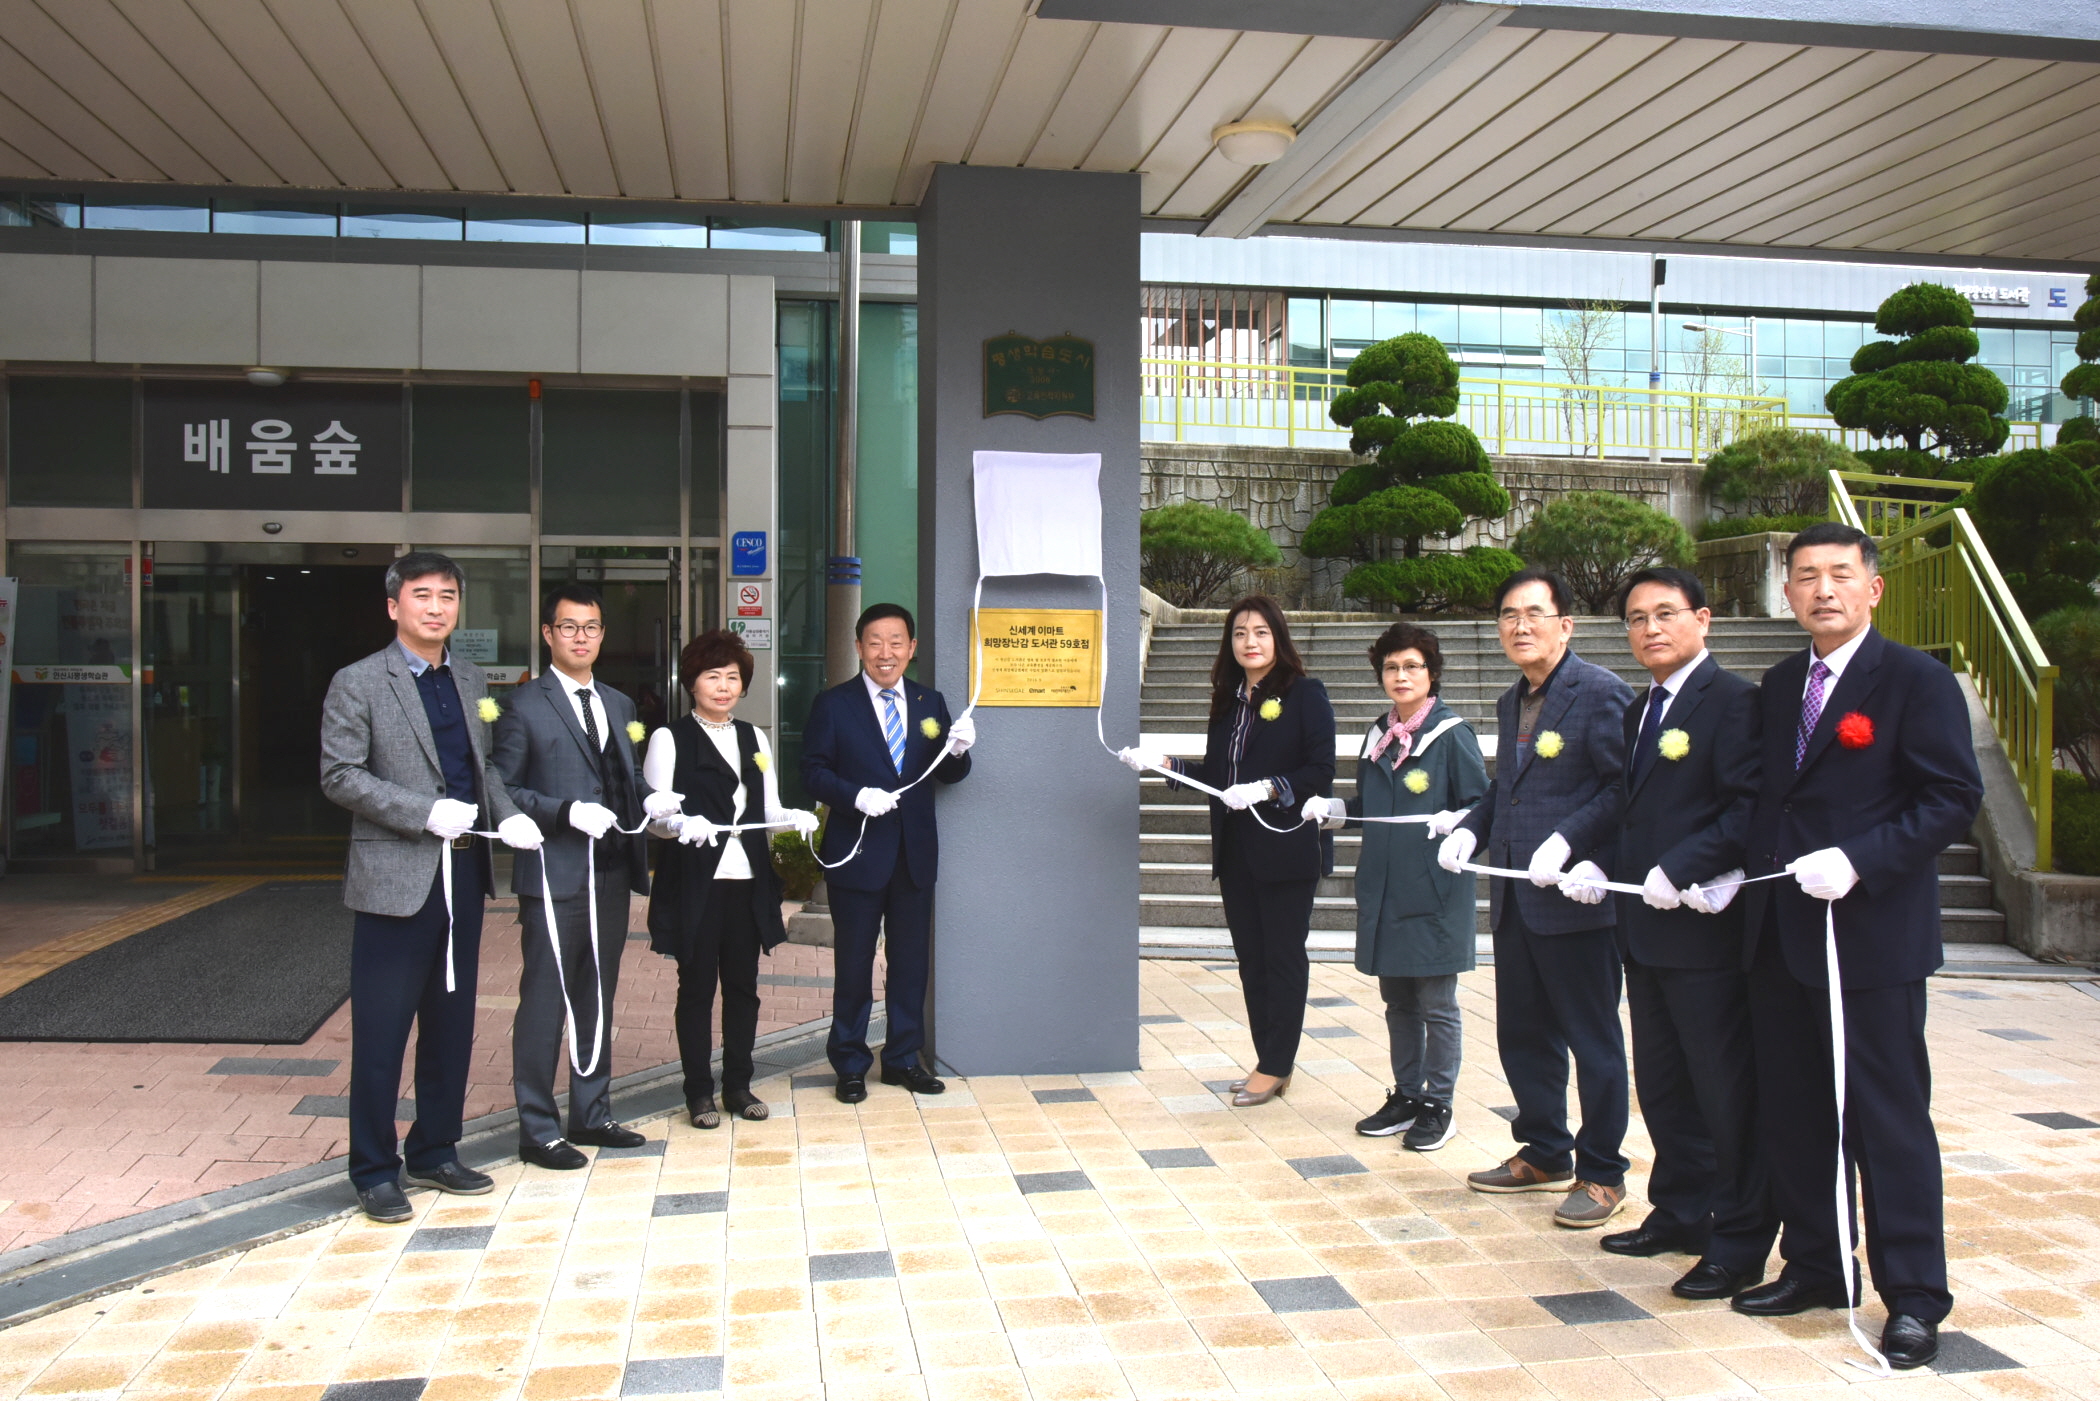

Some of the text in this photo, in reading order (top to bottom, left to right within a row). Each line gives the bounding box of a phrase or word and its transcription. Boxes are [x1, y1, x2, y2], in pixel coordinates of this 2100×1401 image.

[183, 418, 362, 475] 배움숲
[736, 538, 763, 547] CESCO
[1009, 625, 1064, 636] 신세계 이마트
[984, 637, 1090, 649] 희망장난감 도서관 59호점
[53, 671, 109, 681] 안산시평생학습관
